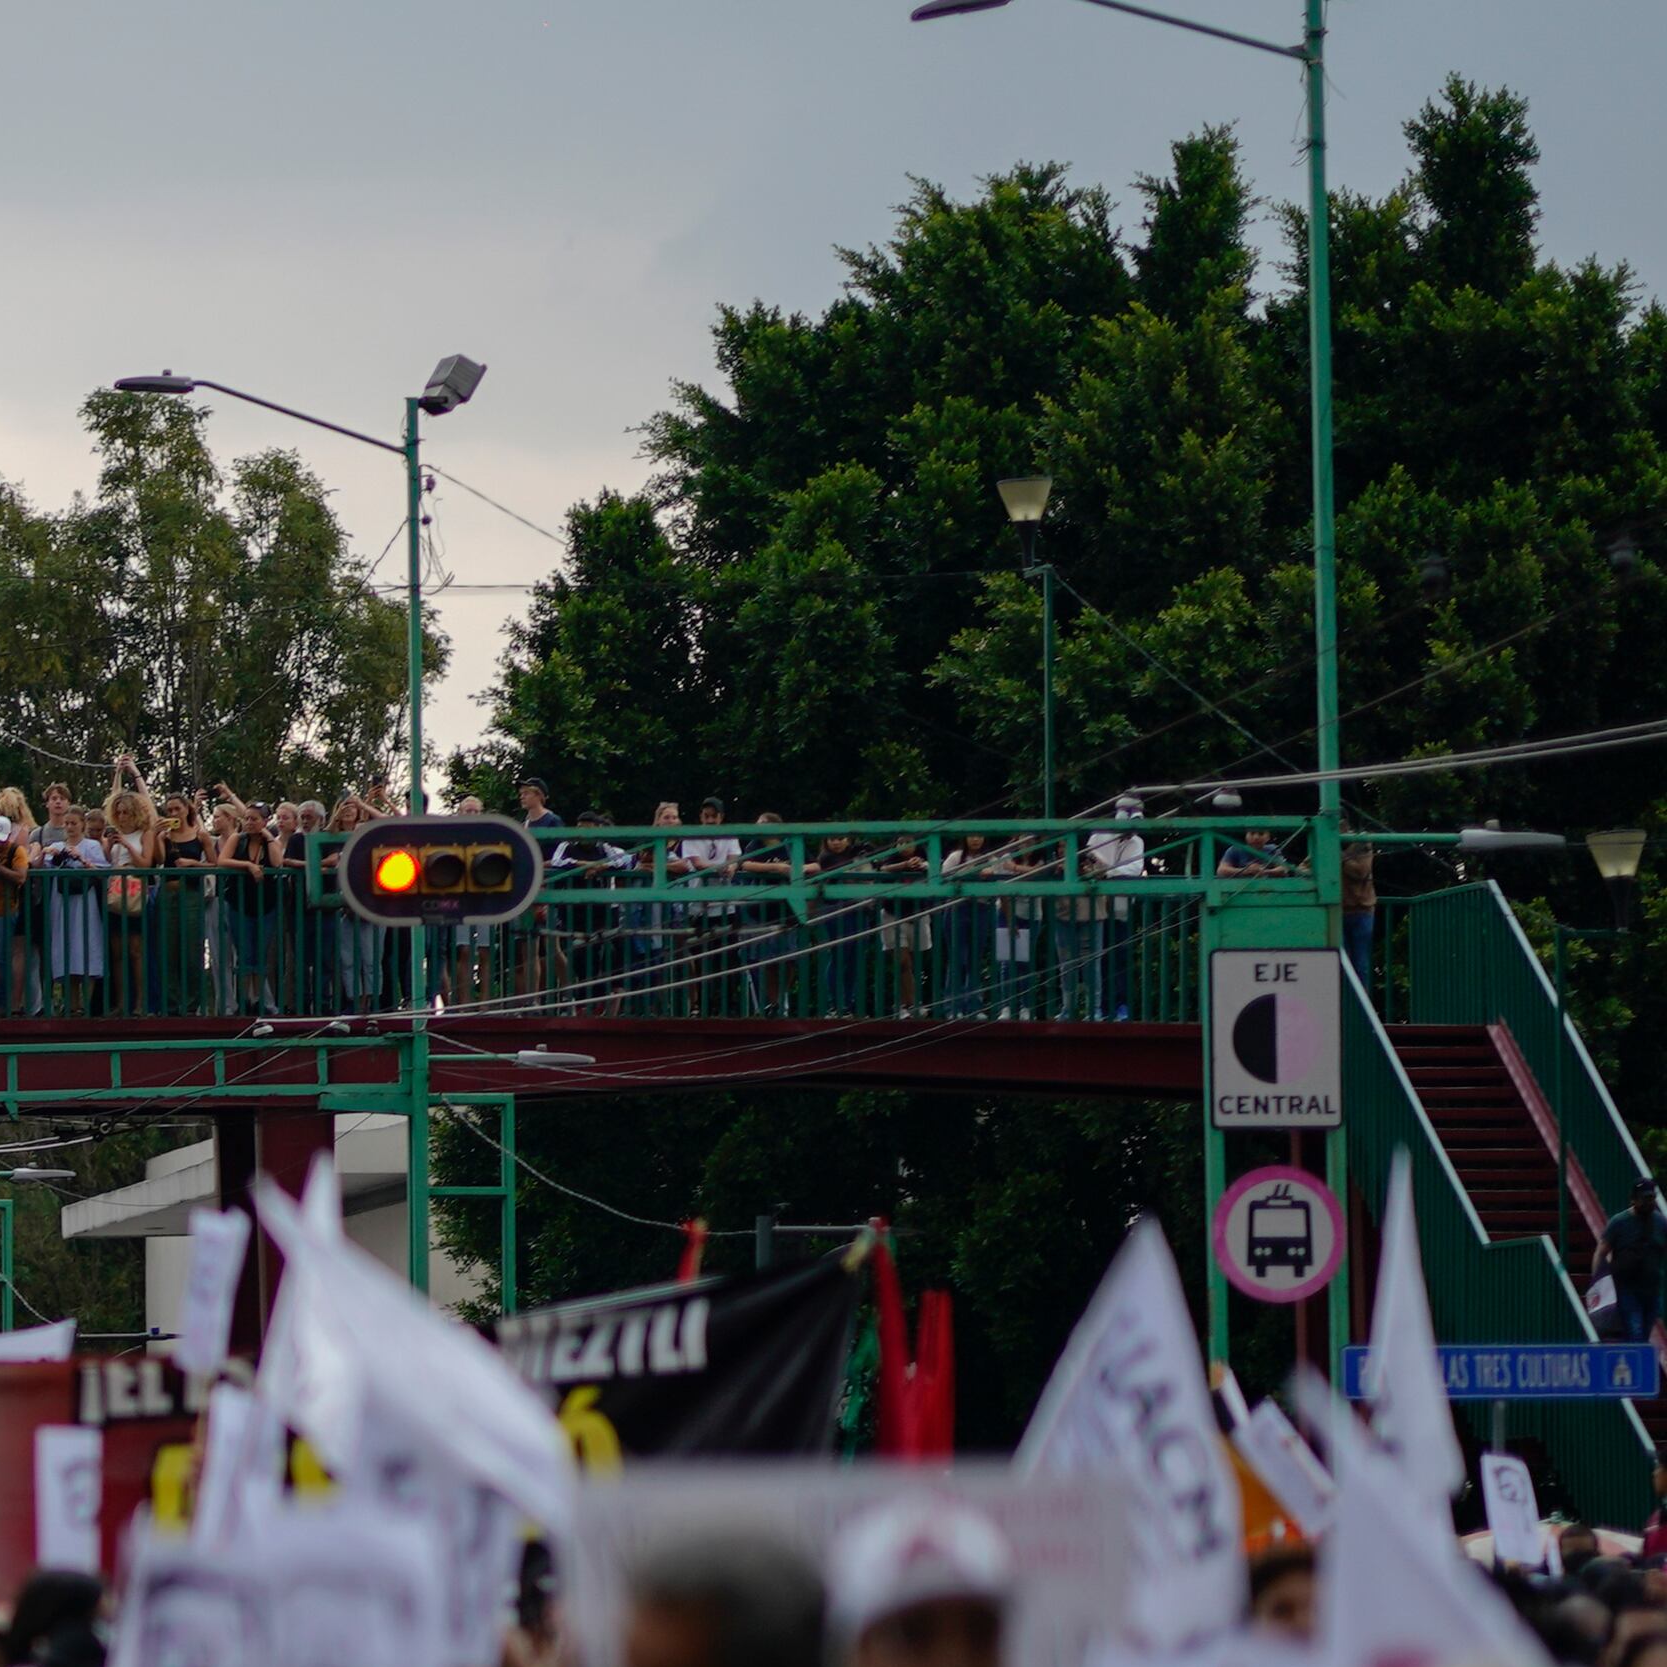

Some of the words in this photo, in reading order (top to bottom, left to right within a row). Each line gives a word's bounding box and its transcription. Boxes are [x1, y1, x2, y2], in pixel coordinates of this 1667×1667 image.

[1255, 963, 1298, 982] EJE
[1219, 1095, 1336, 1114] CENTRAL
[1474, 1354, 1511, 1388] TRES
[1519, 1353, 1591, 1388] CULTURAS
